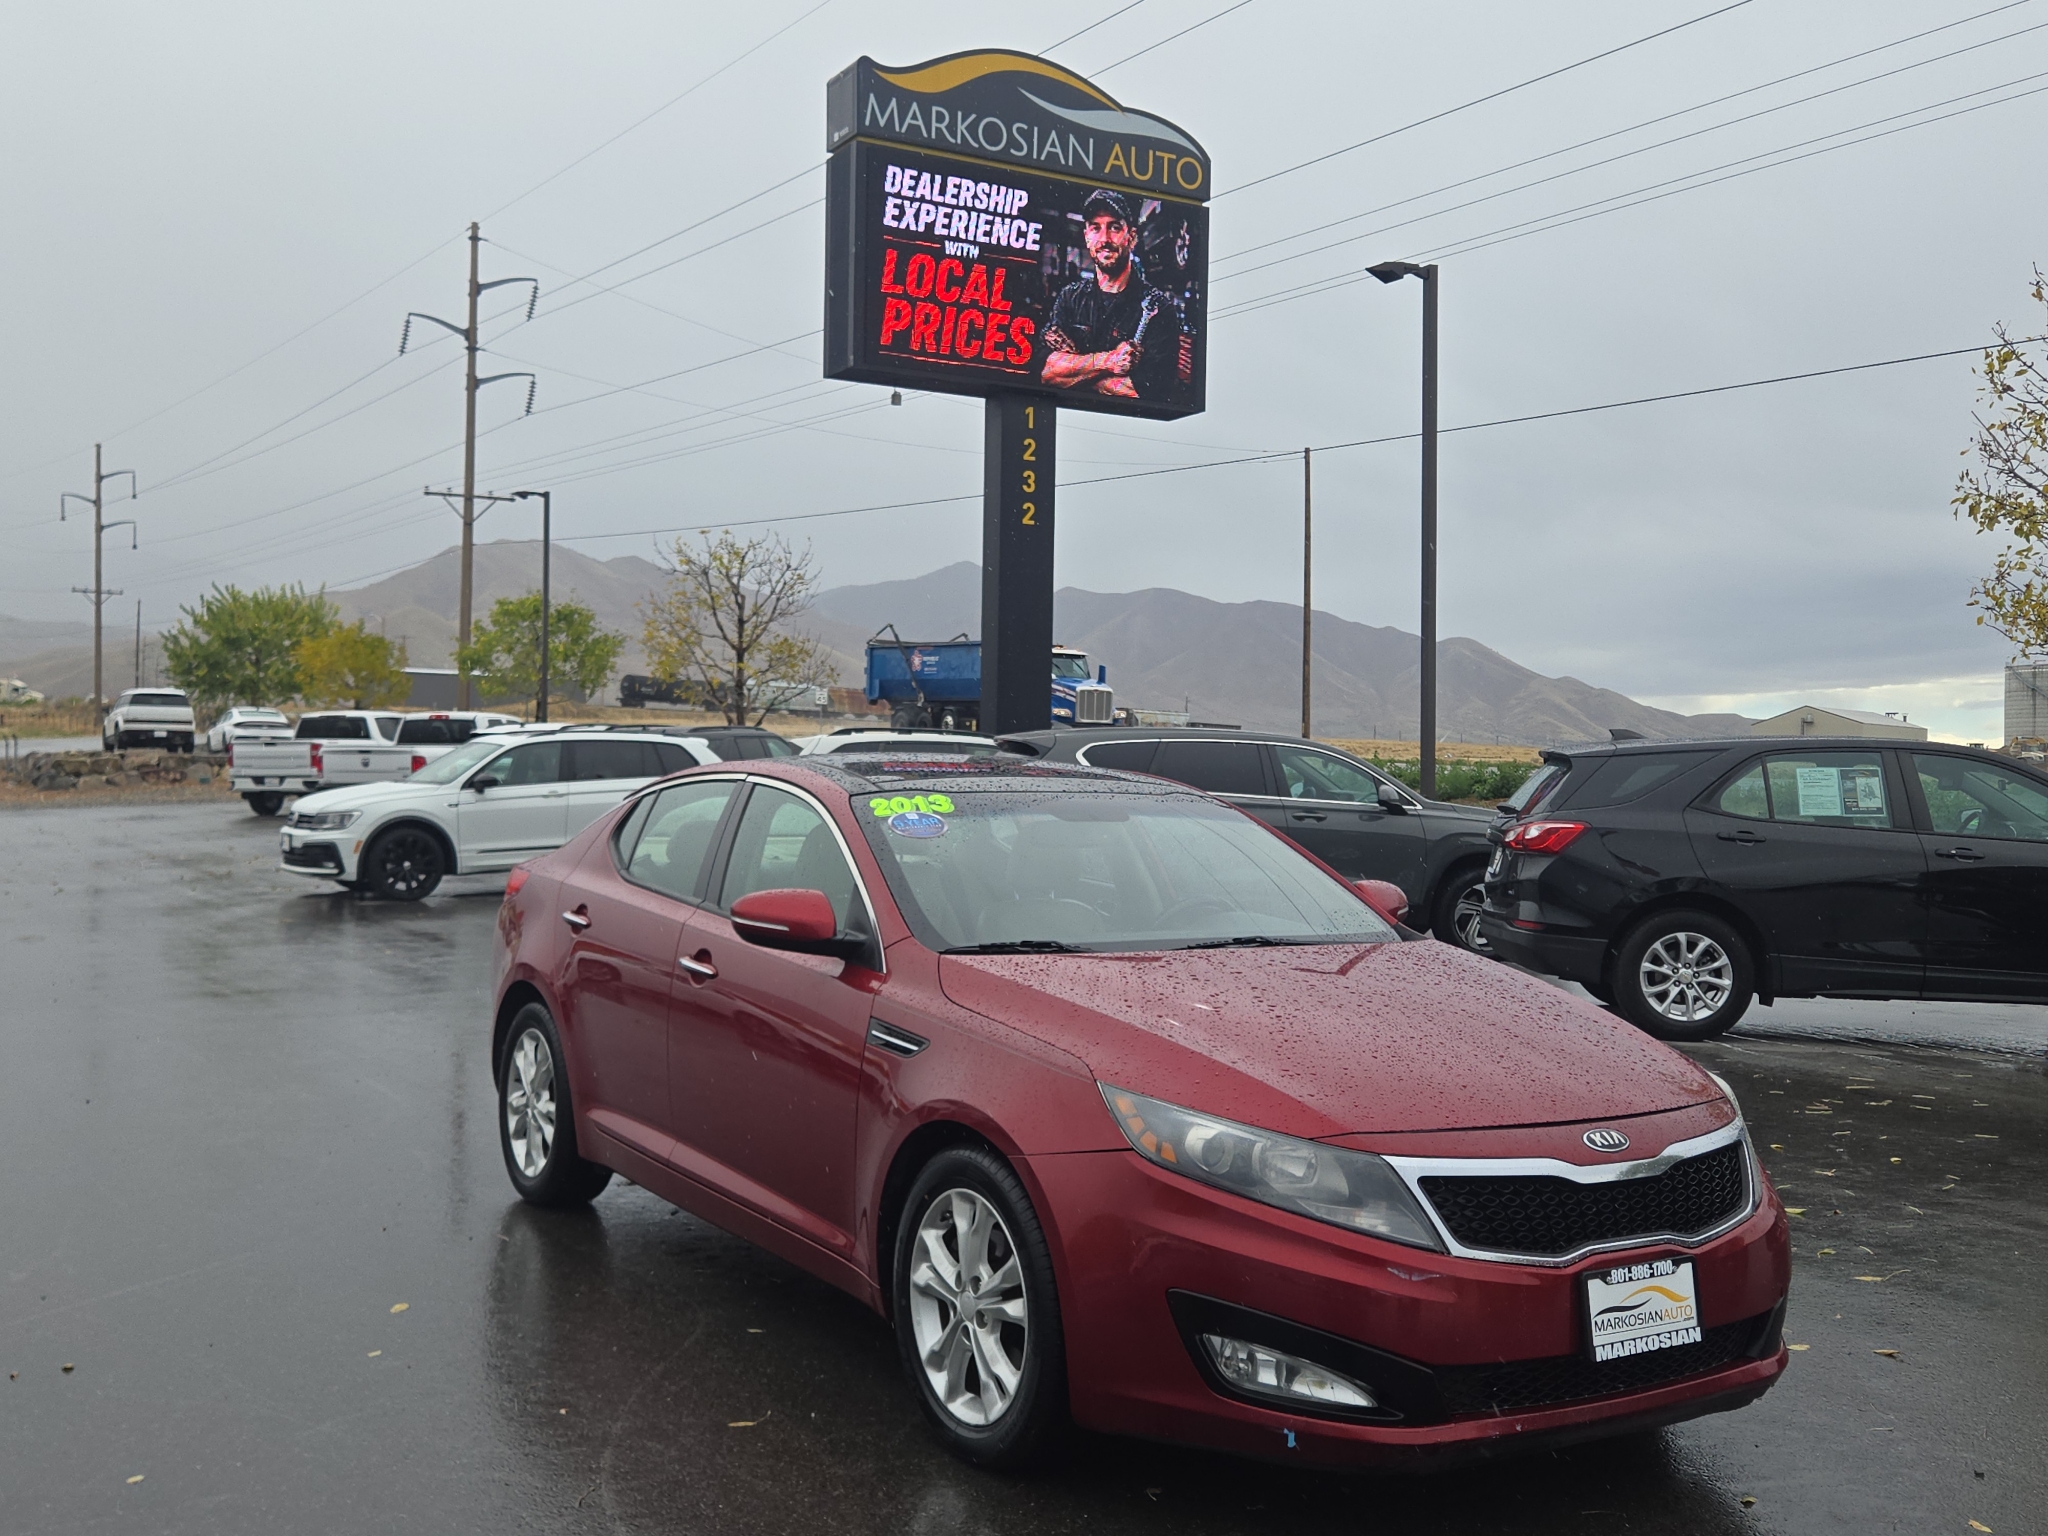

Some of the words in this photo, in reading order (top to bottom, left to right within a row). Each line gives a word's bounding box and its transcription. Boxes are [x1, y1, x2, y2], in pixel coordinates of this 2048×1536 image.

[864, 92, 1096, 171] MARKOSIAN
[1104, 143, 1203, 190] AUTO
[884, 164, 1029, 217] DEALERSHIP
[883, 196, 1043, 252] EXPERIENCE
[944, 240, 980, 260] WITH
[881, 248, 1013, 310] LOCAL
[880, 297, 1036, 365] PRICES
[869, 794, 955, 817] 2013
[1590, 1131, 1625, 1146] KIA
[1611, 1260, 1673, 1284] 801-886-1700
[1595, 1326, 1702, 1363] MARKOSIAN
